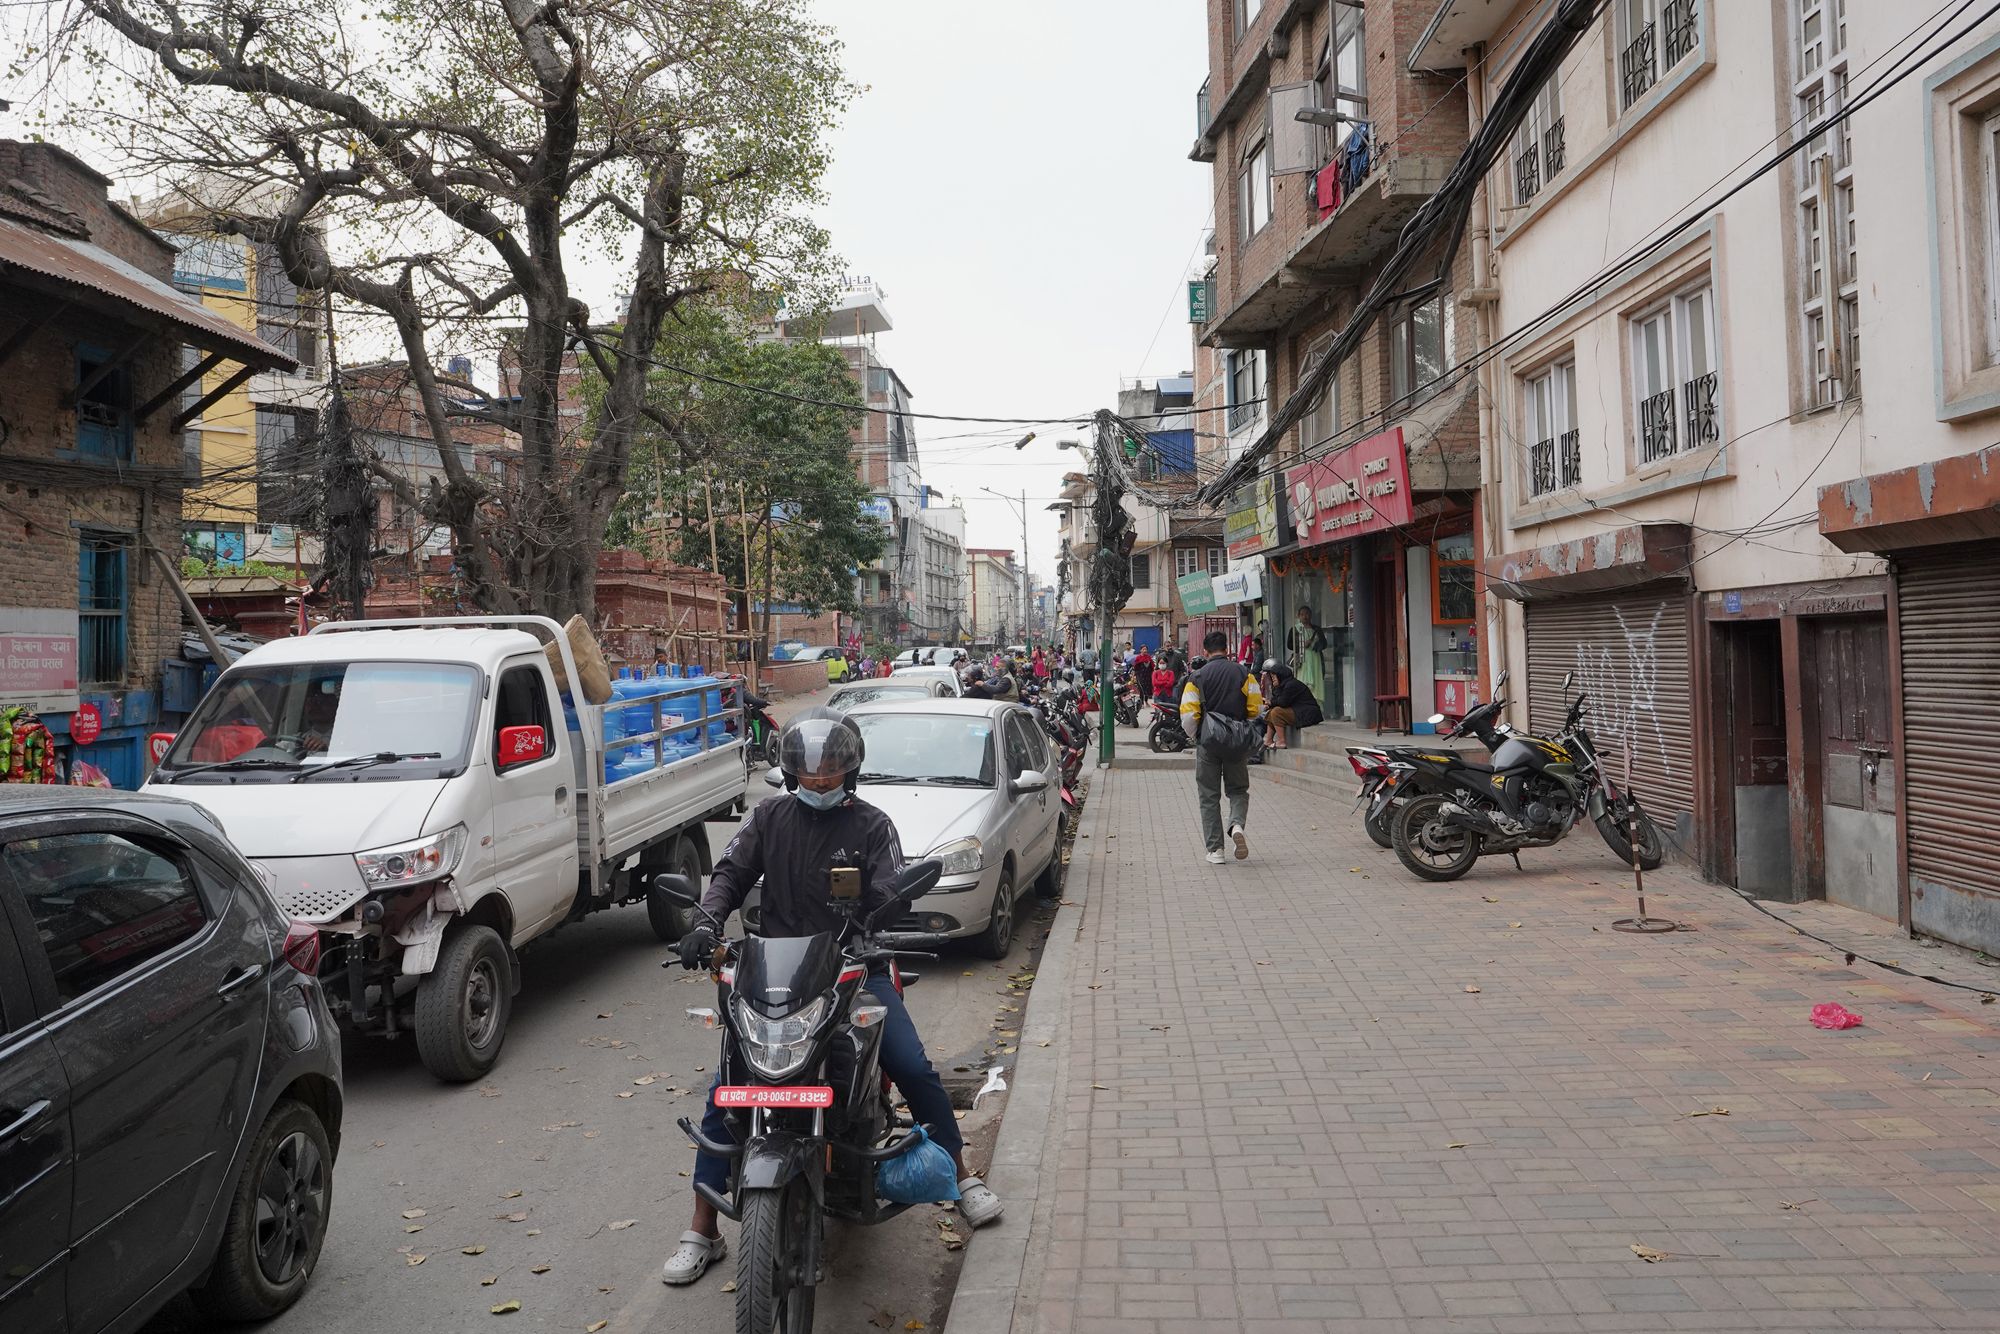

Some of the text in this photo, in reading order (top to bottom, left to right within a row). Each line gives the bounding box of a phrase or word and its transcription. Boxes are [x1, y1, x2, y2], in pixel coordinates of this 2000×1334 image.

[1363, 457, 1389, 477] SMART
[1315, 478, 1361, 511] HUAWEI
[8, 655, 39, 669] किराना
[42, 658, 64, 670] पसल
[720, 1091, 728, 1102] बा
